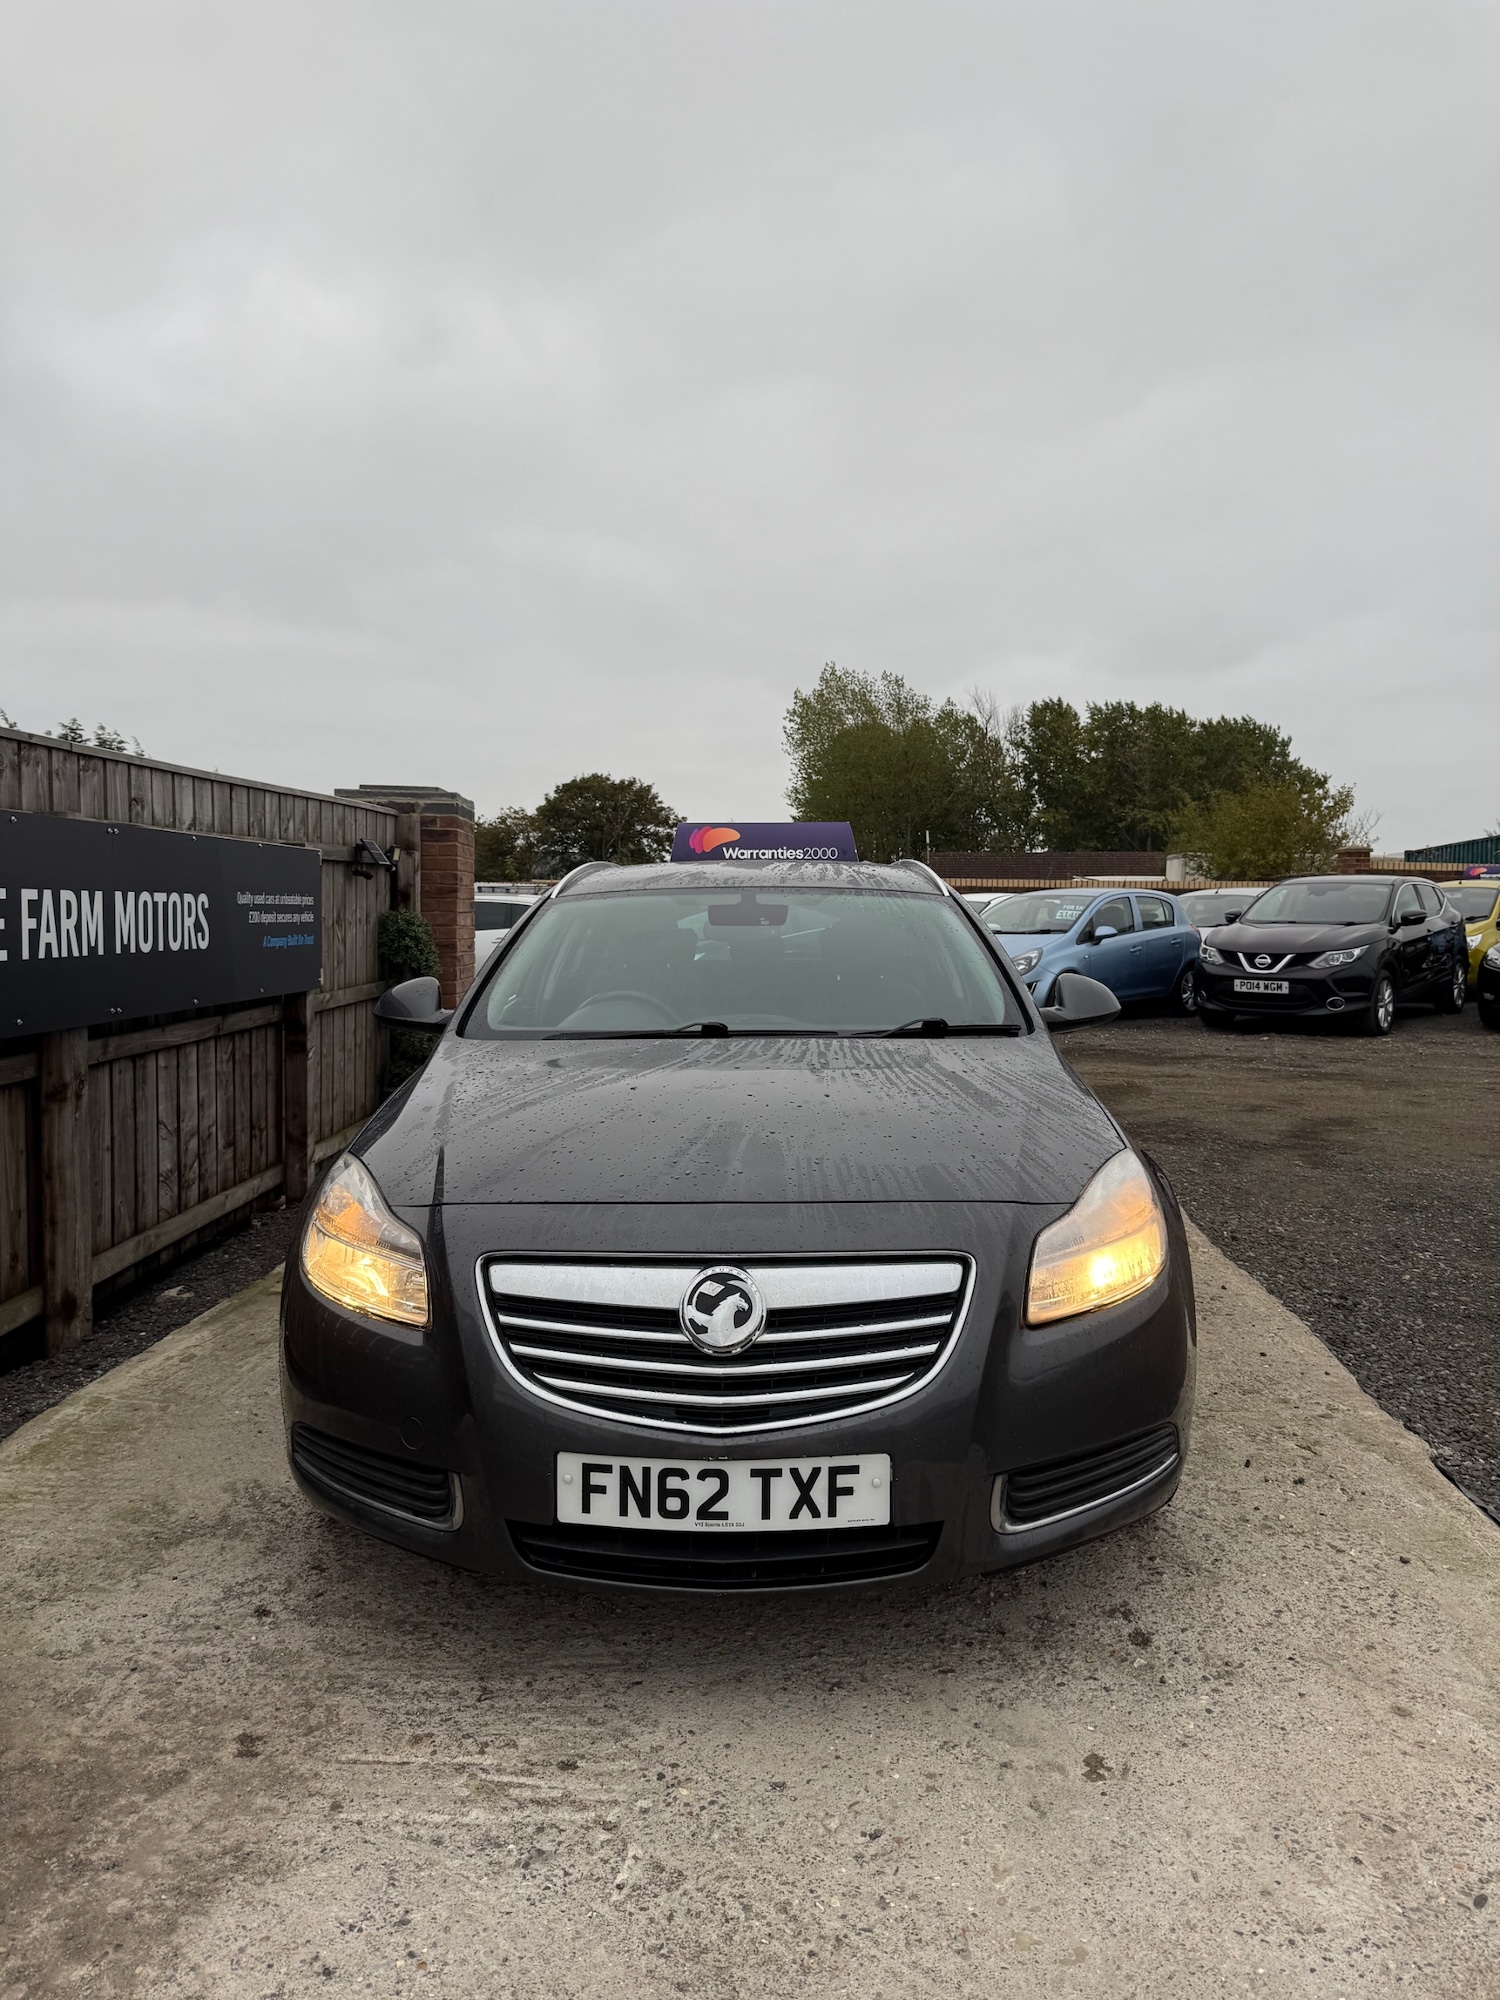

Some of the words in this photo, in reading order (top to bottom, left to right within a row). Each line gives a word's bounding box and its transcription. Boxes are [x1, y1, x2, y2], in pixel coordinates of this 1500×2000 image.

[722, 846, 839, 860] Warranties2000
[237, 891, 253, 907] Quality
[254, 892, 265, 904] used
[21, 888, 105, 960] FARM
[114, 891, 210, 954] MOTORS
[581, 1462, 729, 1520] FN62
[750, 1465, 860, 1520] TXF
